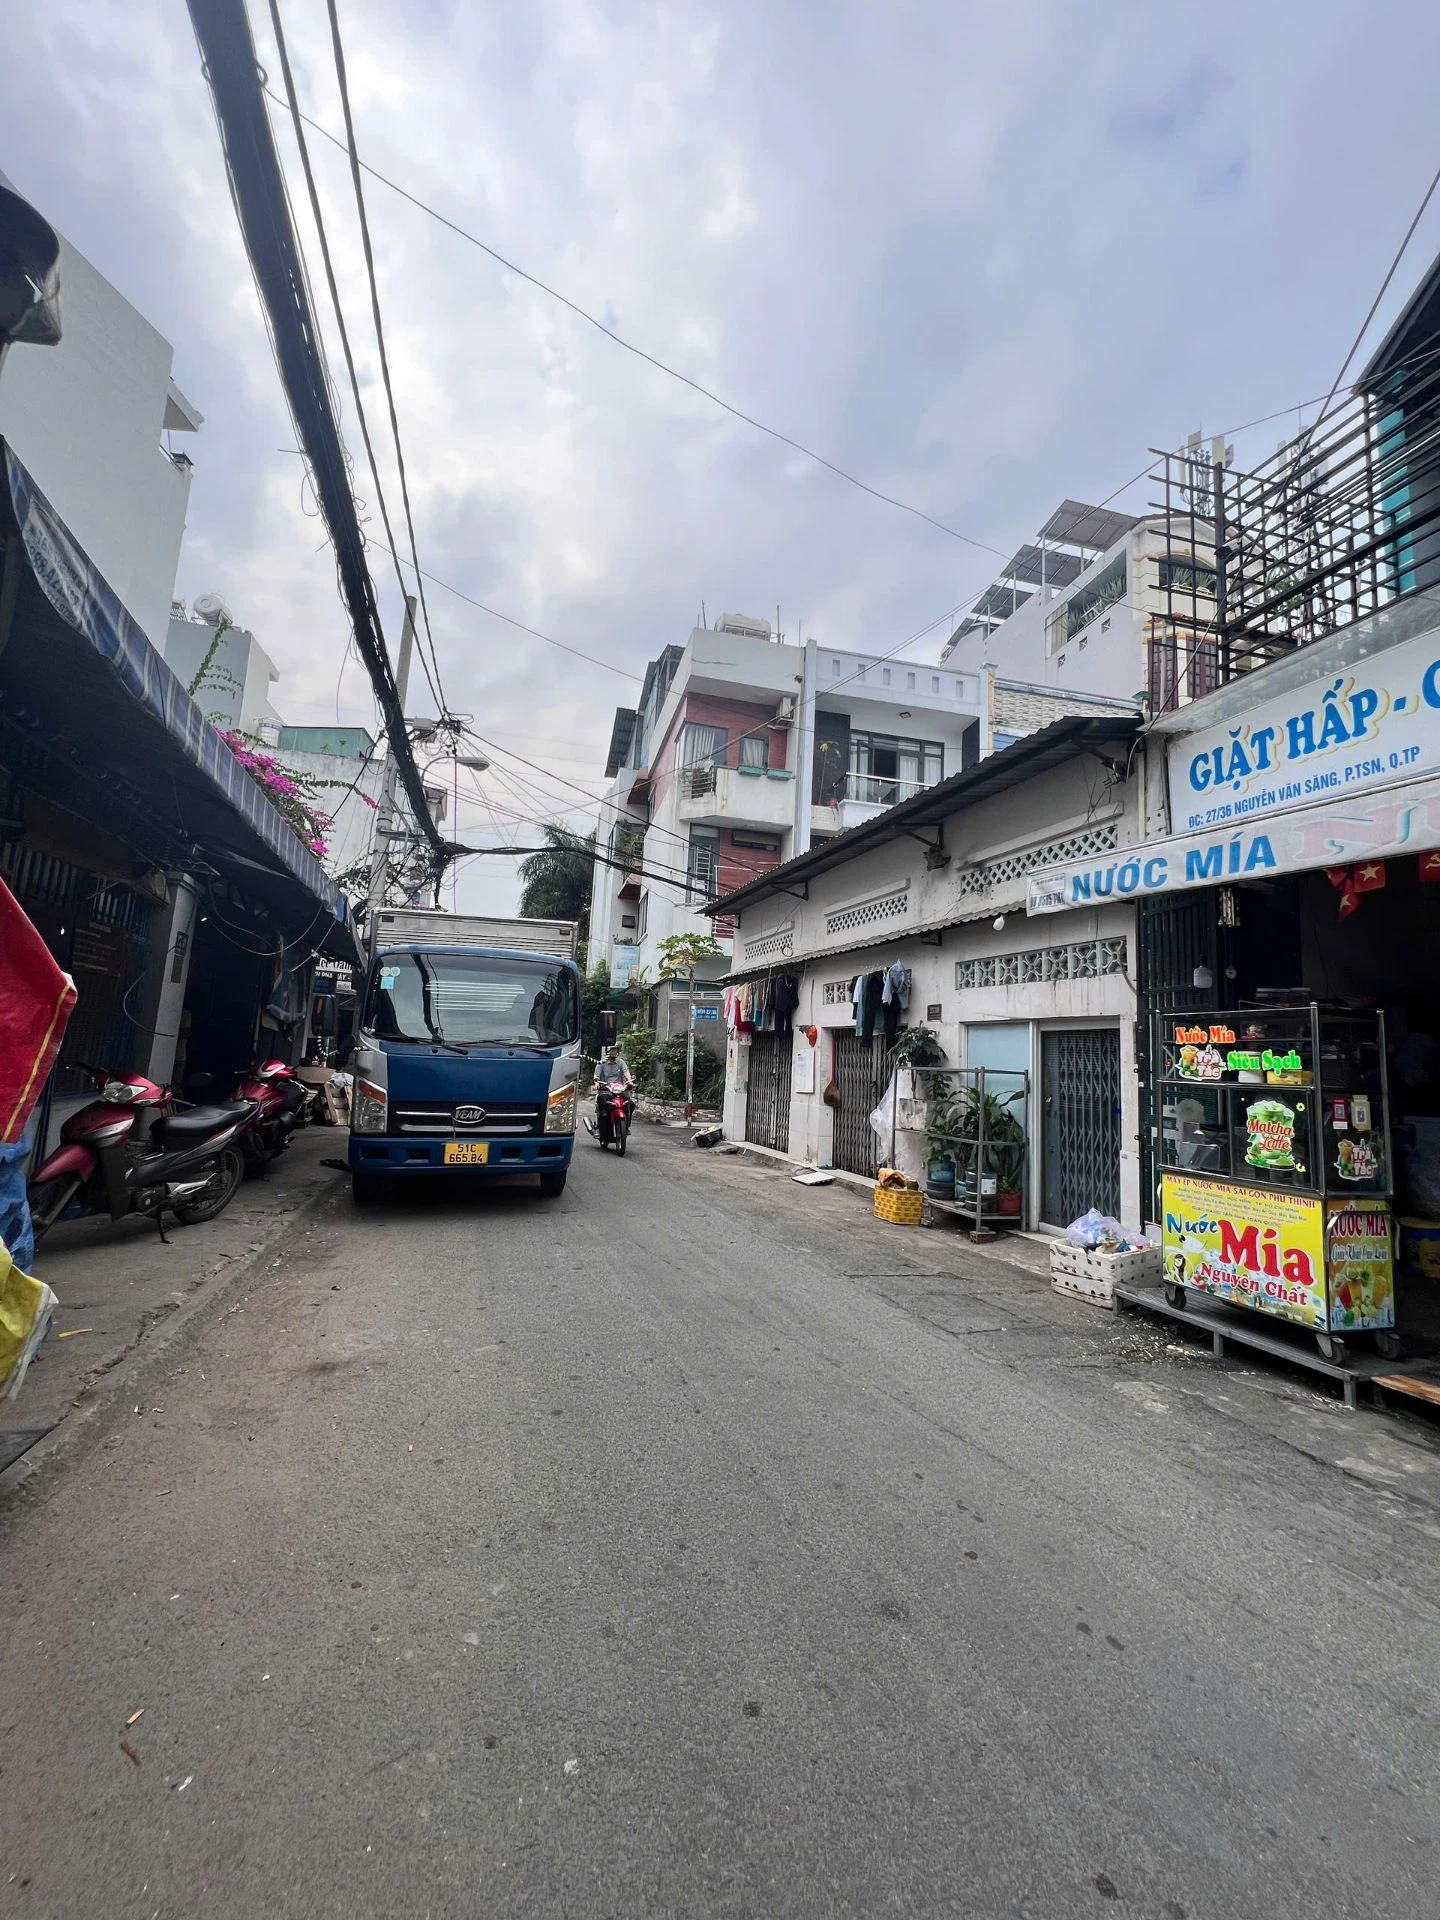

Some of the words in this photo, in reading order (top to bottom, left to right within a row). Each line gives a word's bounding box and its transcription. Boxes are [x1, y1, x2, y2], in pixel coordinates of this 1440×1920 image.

[1189, 725, 1276, 791] GIẶT
[1286, 678, 1378, 760] HẤP
[1205, 805, 1232, 823] 27/36
[1234, 788, 1276, 815] NGUYỄN
[1278, 782, 1301, 801] VĂN
[1304, 771, 1341, 793] SĂNG,
[1344, 757, 1386, 782] P.TSN,
[1389, 745, 1420, 769] Q.TP
[1071, 855, 1168, 902] NƯỚC
[1185, 831, 1277, 882] MÍA
[1175, 1025, 1208, 1045] Nước
[1209, 1025, 1236, 1044] Mía
[1227, 1050, 1260, 1071] Siêu
[1262, 1048, 1303, 1077] Sạch
[455, 1110, 482, 1120] VEAM
[1248, 1119, 1293, 1136] Matcha
[457, 1143, 477, 1153] 51C
[1259, 1135, 1290, 1152] Latte
[449, 1153, 483, 1163] 665.84
[1166, 1213, 1218, 1234] Nước
[1218, 1219, 1314, 1286] Mía
[1201, 1263, 1260, 1292] Nguyên
[1265, 1282, 1308, 1305] Chất
